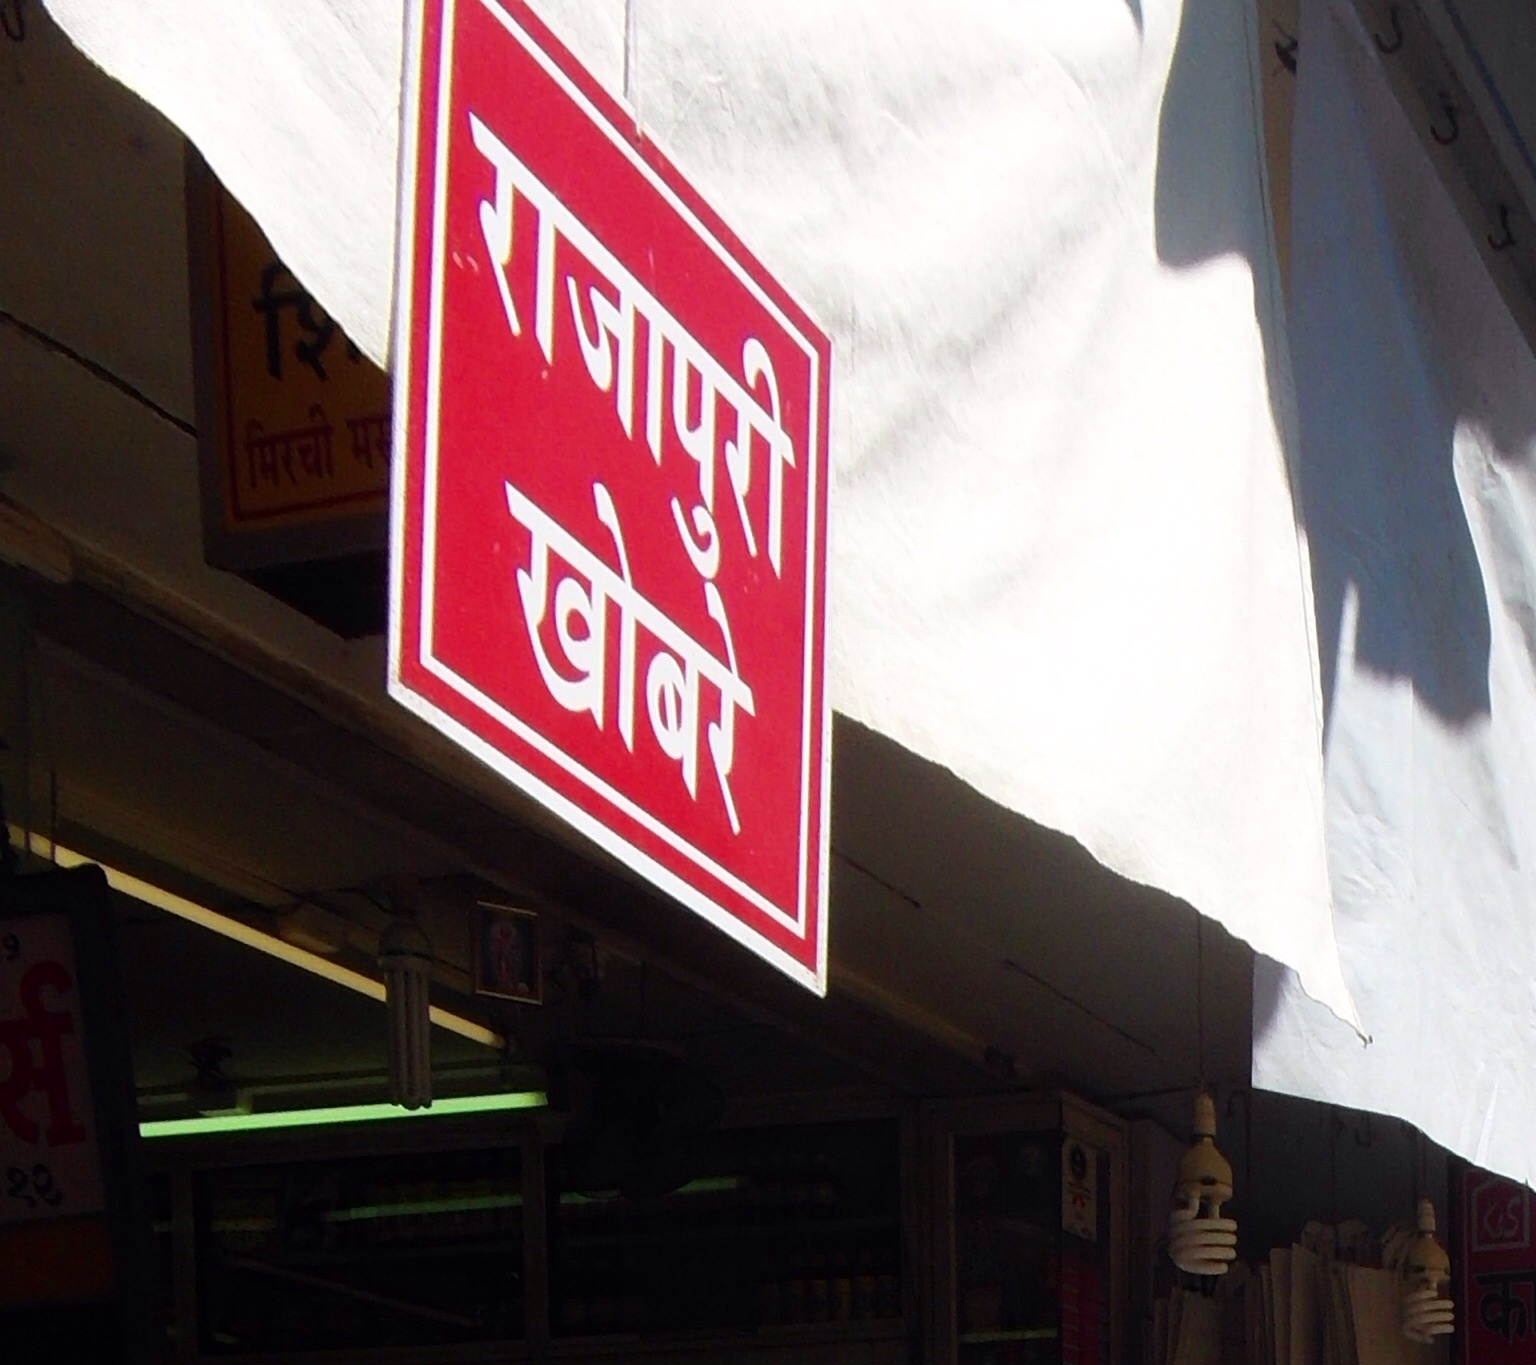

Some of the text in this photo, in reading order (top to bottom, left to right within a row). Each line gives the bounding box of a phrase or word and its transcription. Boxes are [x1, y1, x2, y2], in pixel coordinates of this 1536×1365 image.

[246, 402, 333, 489] मिरची
[467, 109, 796, 581] राजापुरी
[503, 480, 756, 837] खोबरे
